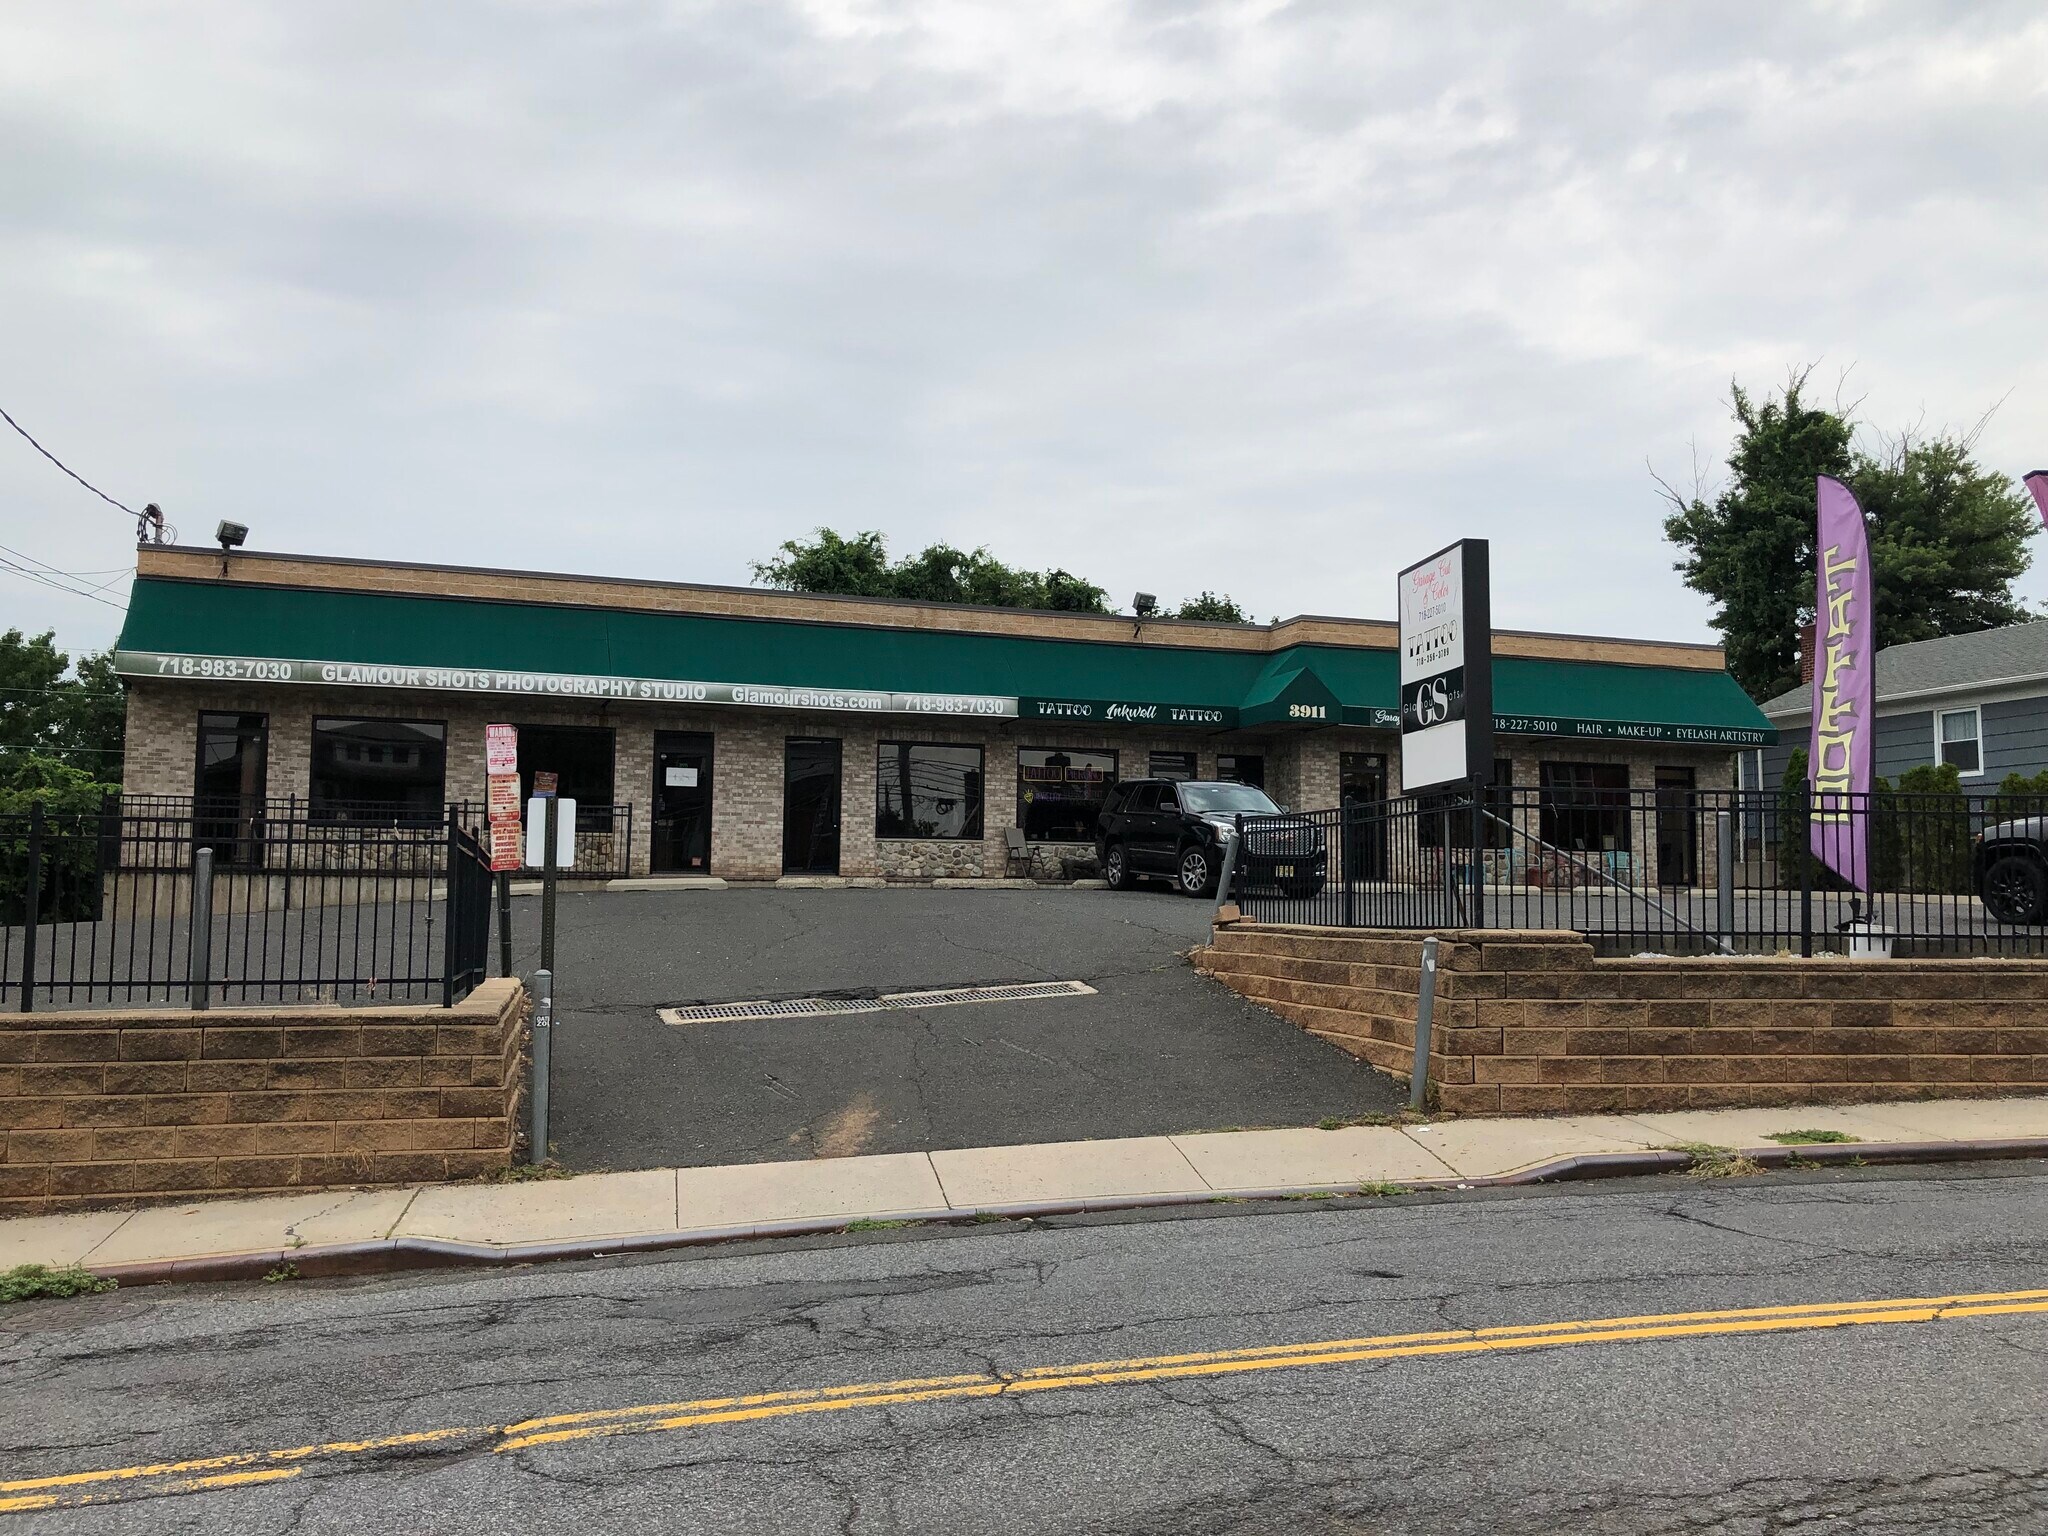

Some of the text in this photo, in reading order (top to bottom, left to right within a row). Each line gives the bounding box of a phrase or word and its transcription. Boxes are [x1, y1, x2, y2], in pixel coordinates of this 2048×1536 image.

[1412, 557, 1452, 593] Garage Cut
[1430, 581, 1449, 600] Color
[1418, 602, 1447, 622] 718-227-5010
[1407, 619, 1458, 658] TATTOO
[156, 656, 292, 680] 718-983-7030
[321, 664, 1004, 714] GLAMOUR SHOTS PHOTOGRAPHY STUDIO Glamourshots.com 718-983-7030
[1416, 676, 1449, 726] GS
[1037, 701, 1223, 723] TATTOO Inkwell TATTOO
[1288, 704, 1327, 720] 3911
[1491, 717, 1765, 744] 18-227-5010 HAIR MAKE-UP EYELASH ARTISTRY
